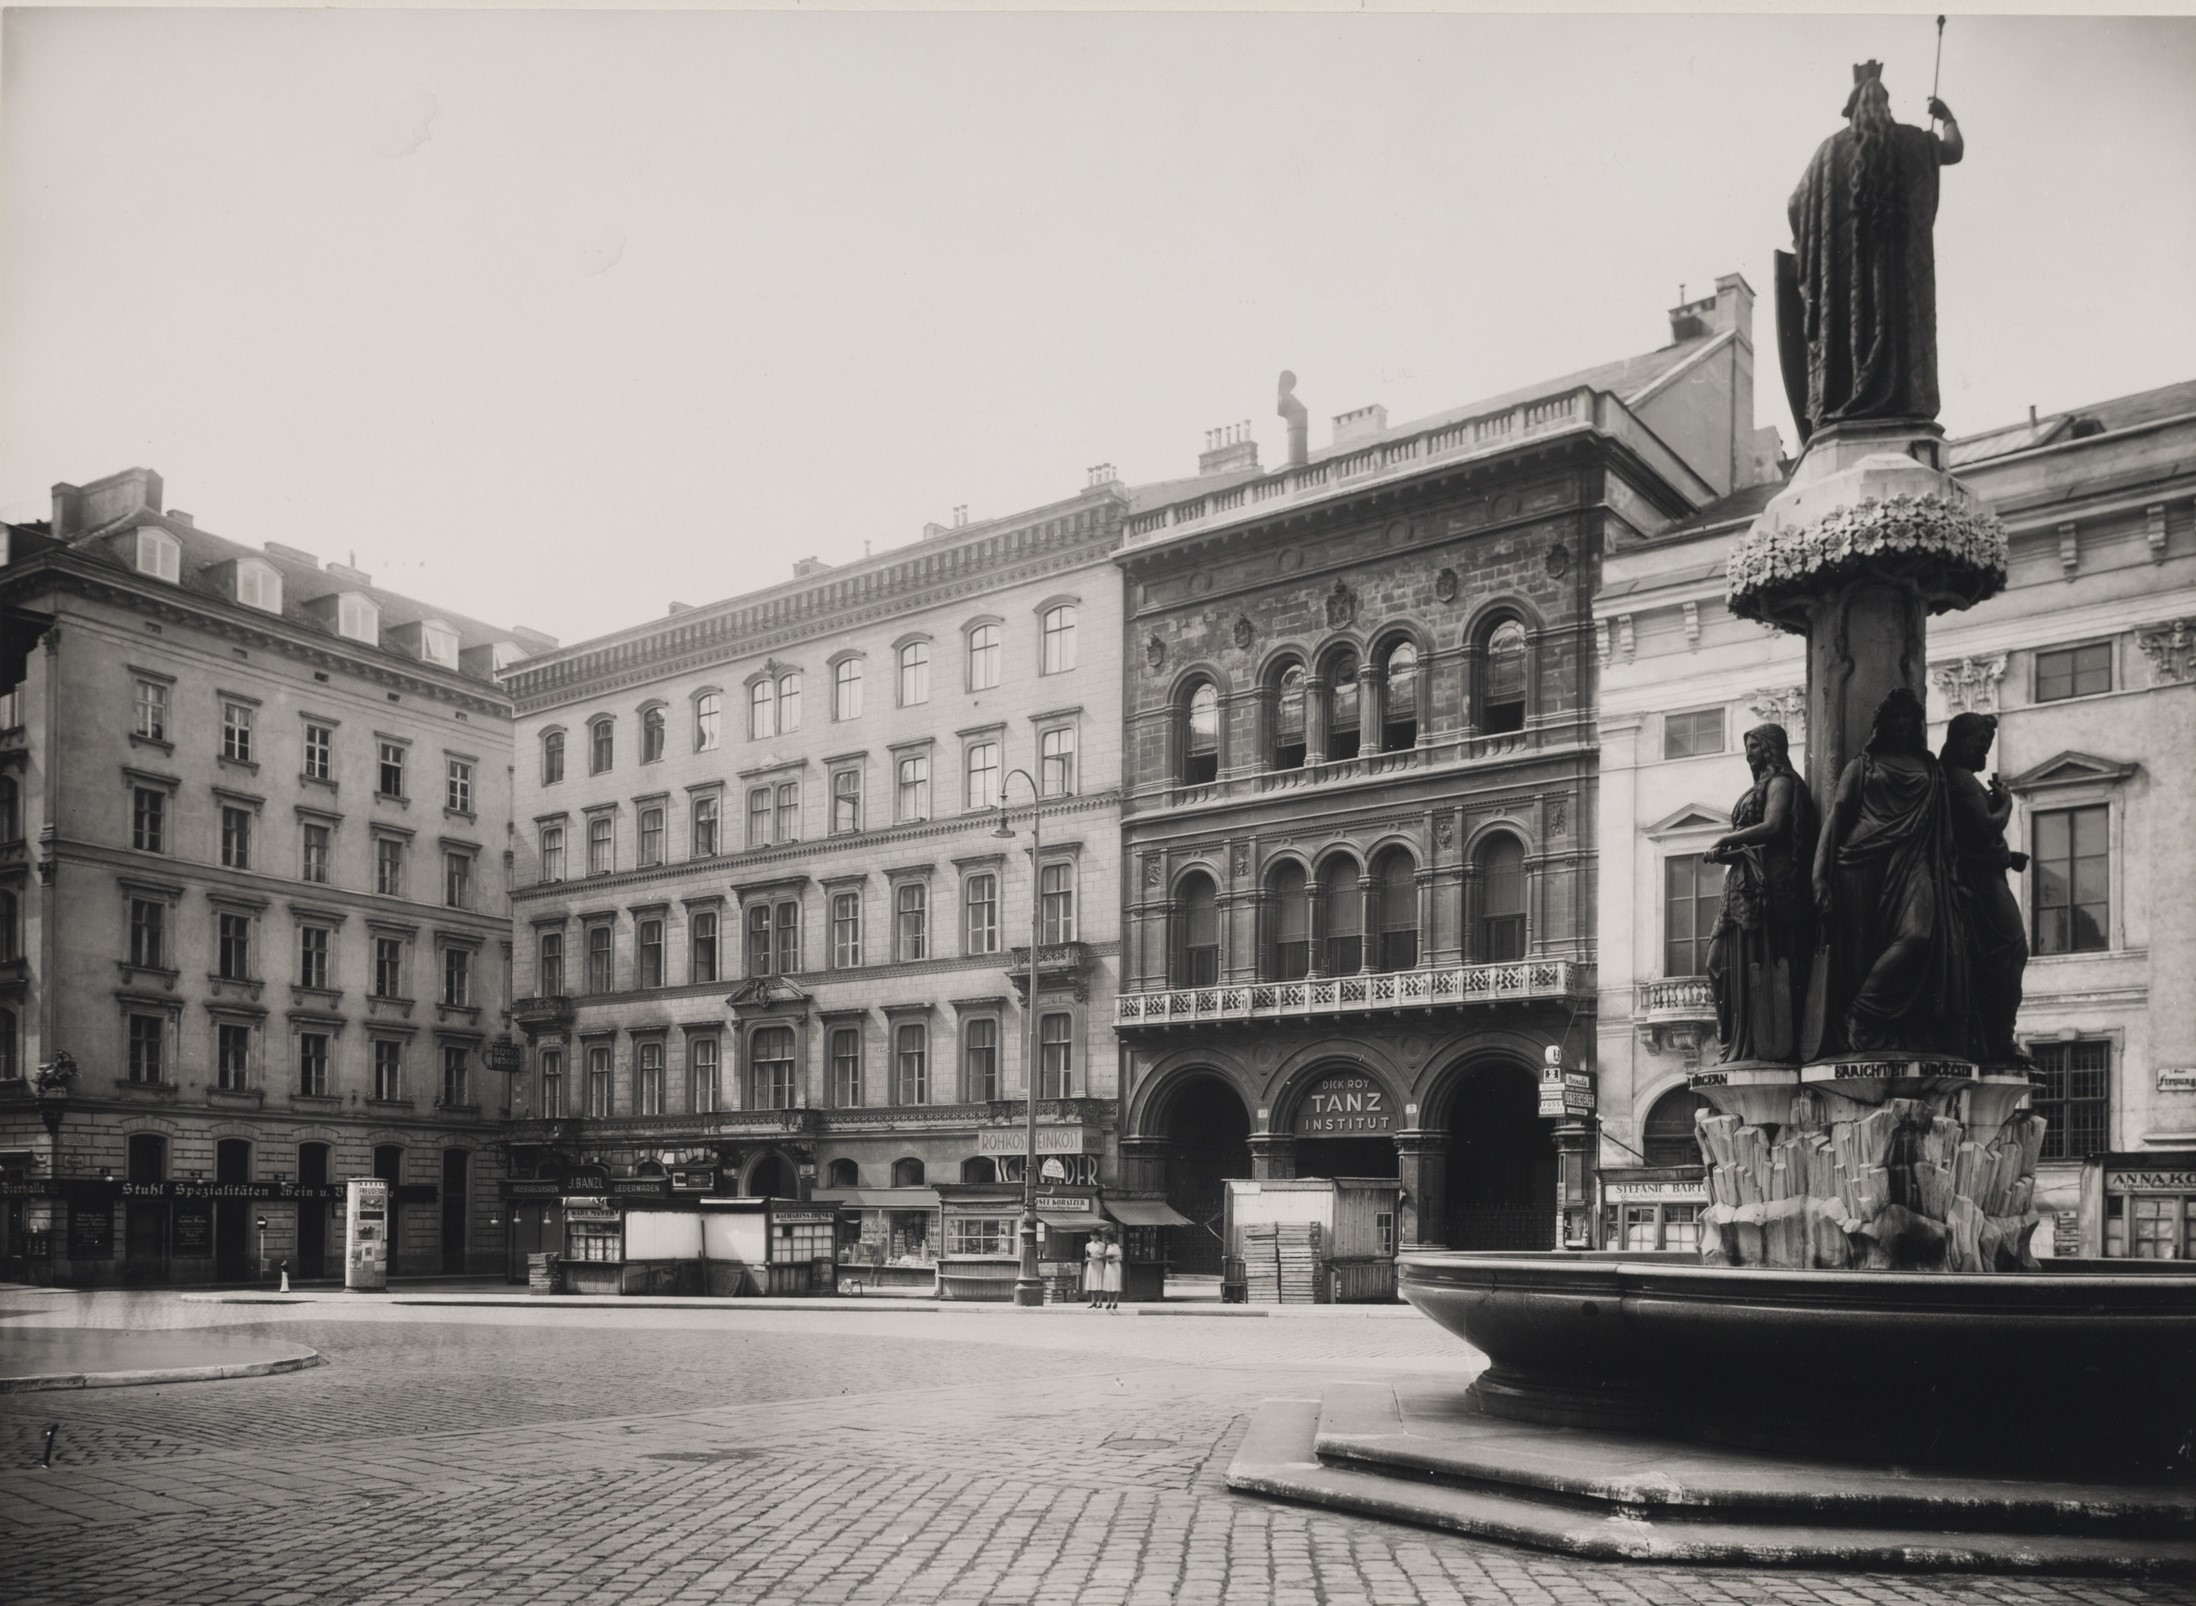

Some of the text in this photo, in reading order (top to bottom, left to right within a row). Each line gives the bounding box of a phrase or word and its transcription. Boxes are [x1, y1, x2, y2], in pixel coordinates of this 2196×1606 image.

[1322, 1079, 1370, 1090] DICK ROY
[1311, 1093, 1381, 1113] TANZ
[1305, 1117, 1390, 1131] INSTITUT
[1037, 1131, 1078, 1149] EINKOST
[995, 1155, 1098, 1185] SCHNDER
[2113, 1174, 2165, 1184] ANNA
[122, 1182, 164, 1197] Stuhl
[175, 1183, 269, 1198] Spezialitäten
[615, 1183, 660, 1192] LEDERWAREN
[1616, 1184, 1665, 1193] STEFANIE
